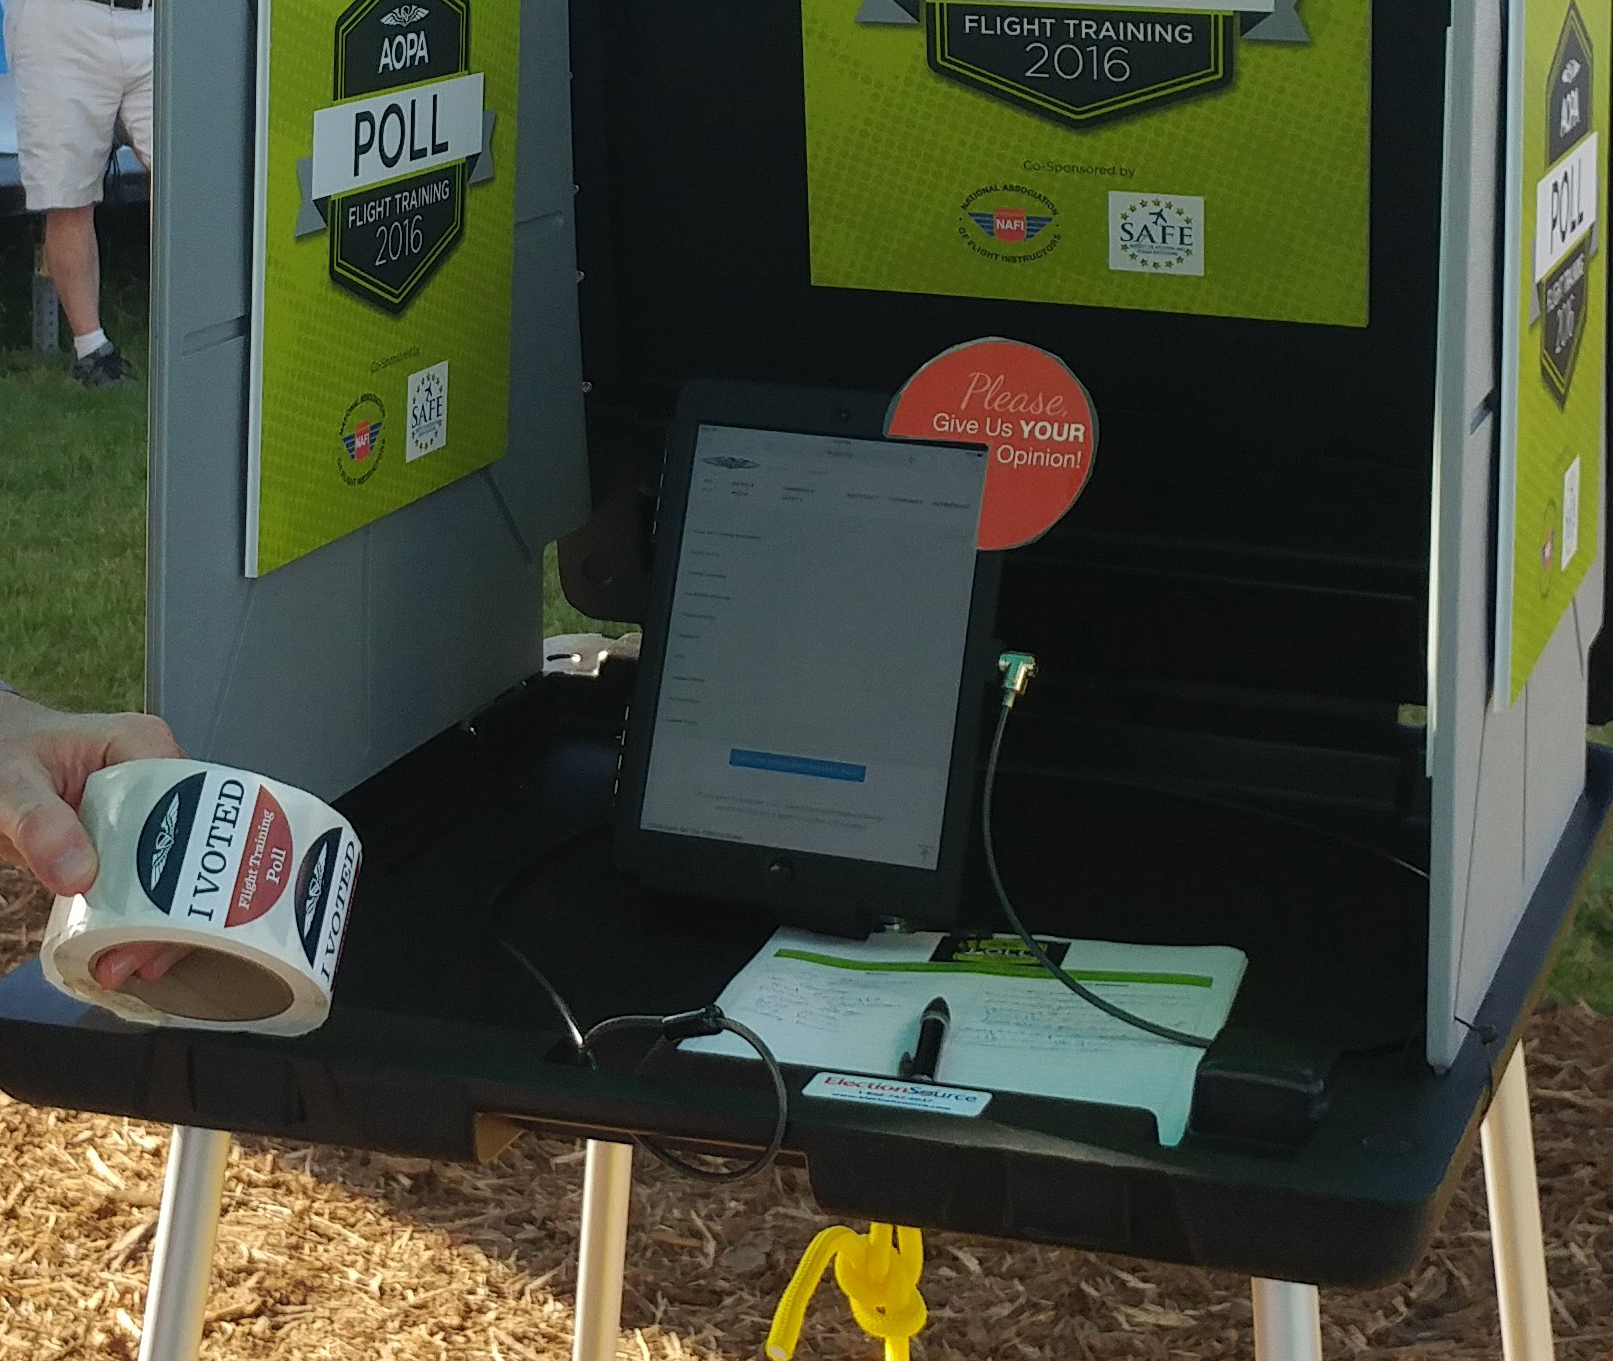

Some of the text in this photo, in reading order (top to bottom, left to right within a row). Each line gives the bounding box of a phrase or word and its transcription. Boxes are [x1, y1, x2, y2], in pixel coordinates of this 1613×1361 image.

[964, 14, 1194, 44] FLIGHT TRAINING
[378, 30, 430, 74] AOPA
[1024, 42, 1132, 82] 2016
[353, 93, 449, 177] POLL
[1023, 159, 1136, 179] Co-Sponsored by
[348, 179, 450, 229] FLIGHT TRAINING
[961, 183, 1060, 216] NATIONAL ASSOCIATION
[1549, 156, 1585, 256] POLL
[374, 214, 424, 266] 2016
[995, 218, 1026, 233] NAFI
[1119, 221, 1195, 247] SAFE
[1000, 233, 1063, 265] INSTRUCTORS
[411, 395, 444, 429] SAFE
[932, 412, 1086, 444] Give Us YOUR
[996, 444, 1082, 469] Opinion!
[187, 778, 245, 922] I VOTED
[237, 808, 275, 910] Flight Training
[265, 846, 287, 886] Poll
[320, 840, 356, 983] I VOTED
[824, 1075, 978, 1103] ElectionSource
